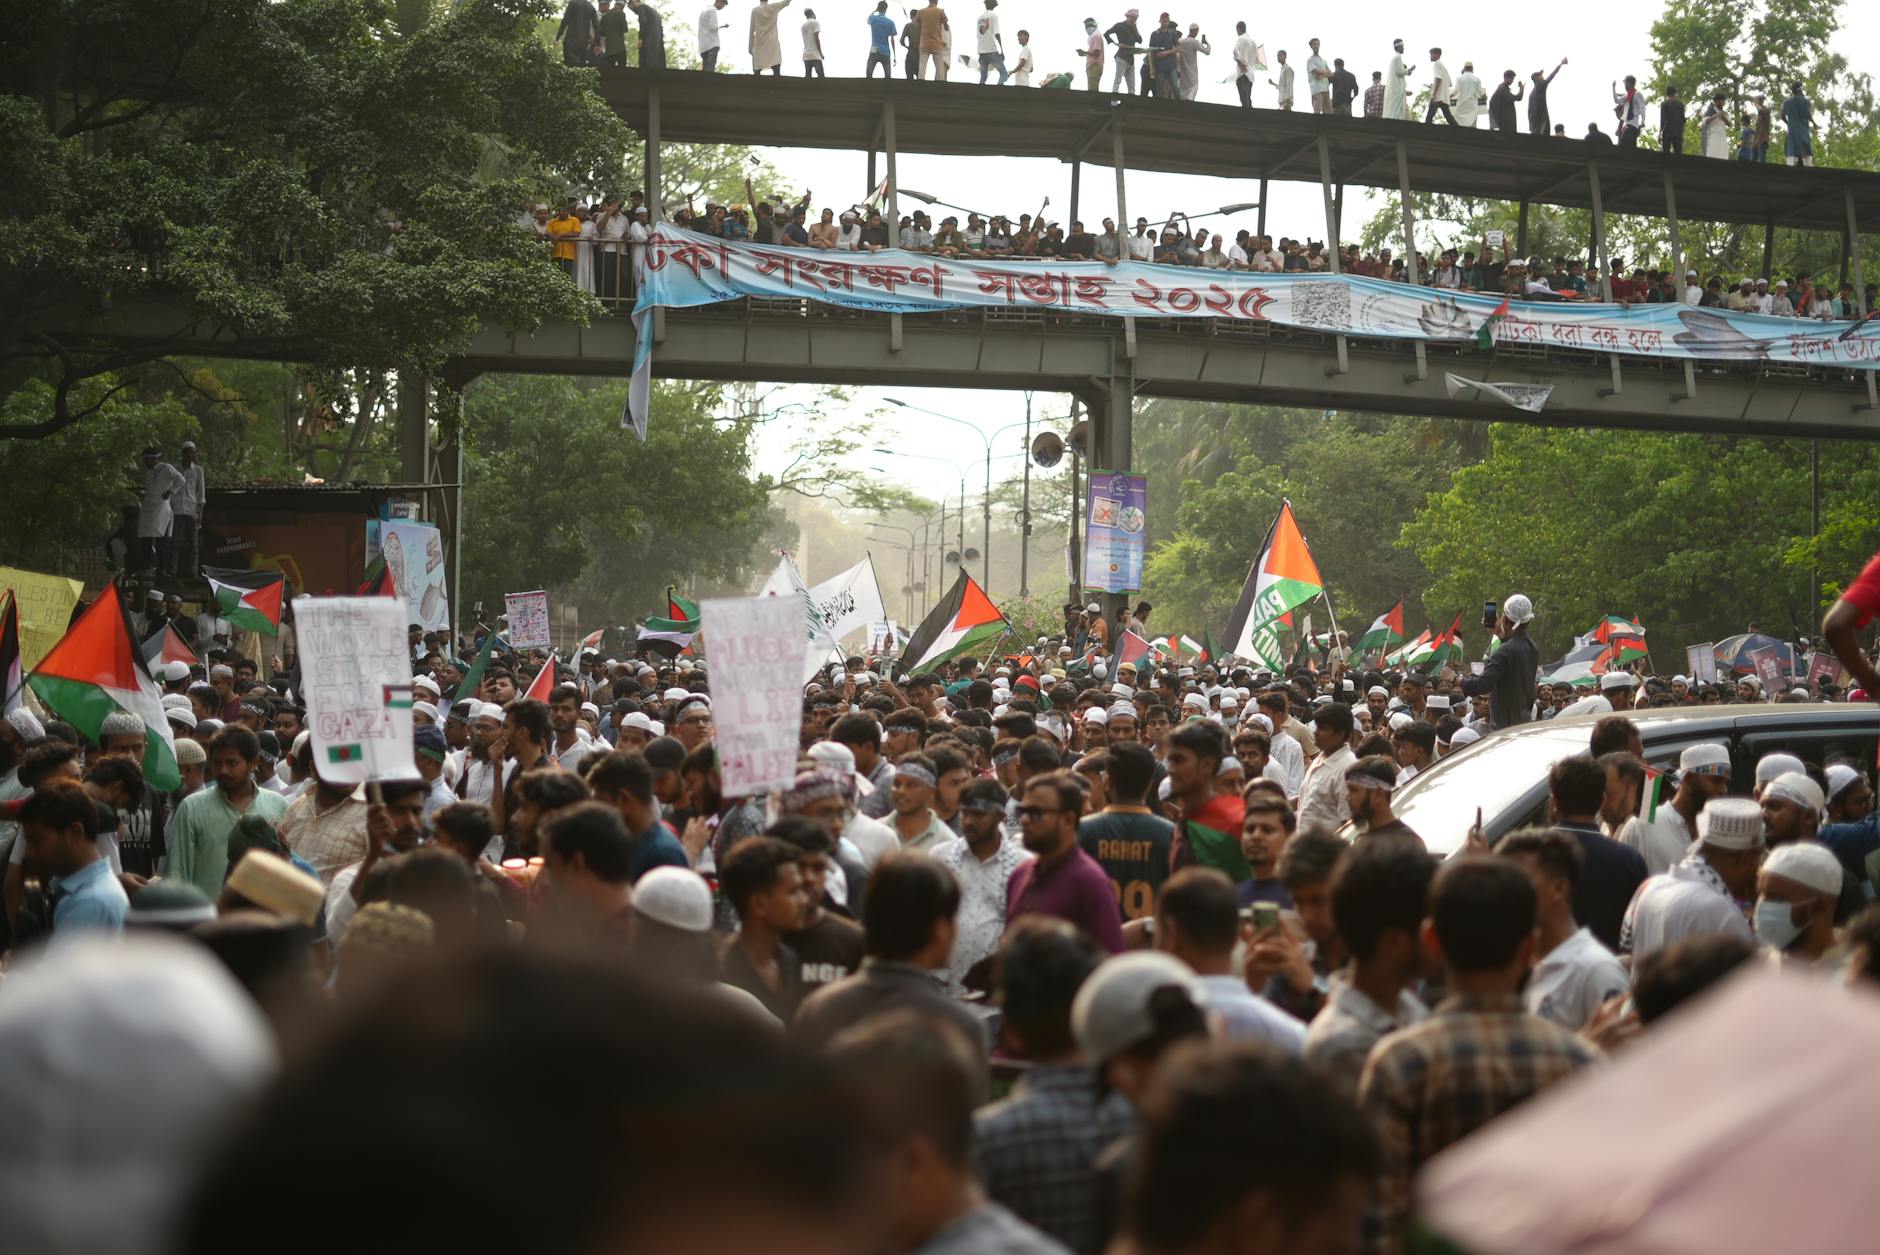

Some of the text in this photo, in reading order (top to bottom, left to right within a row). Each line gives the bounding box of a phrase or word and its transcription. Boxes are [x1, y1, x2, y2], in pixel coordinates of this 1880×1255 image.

[755, 250, 951, 298] সংরক্ষণ
[972, 270, 1115, 308] সপ্তাহ
[1131, 278, 1278, 321] ২০২৫
[304, 602, 370, 628] THE
[306, 626, 408, 657] WORLD
[314, 655, 401, 685] STOPS
[314, 682, 378, 713] FOR
[316, 708, 398, 742] GAZA
[1098, 840, 1153, 861] RAHAT
[1110, 880, 1154, 918] 0
